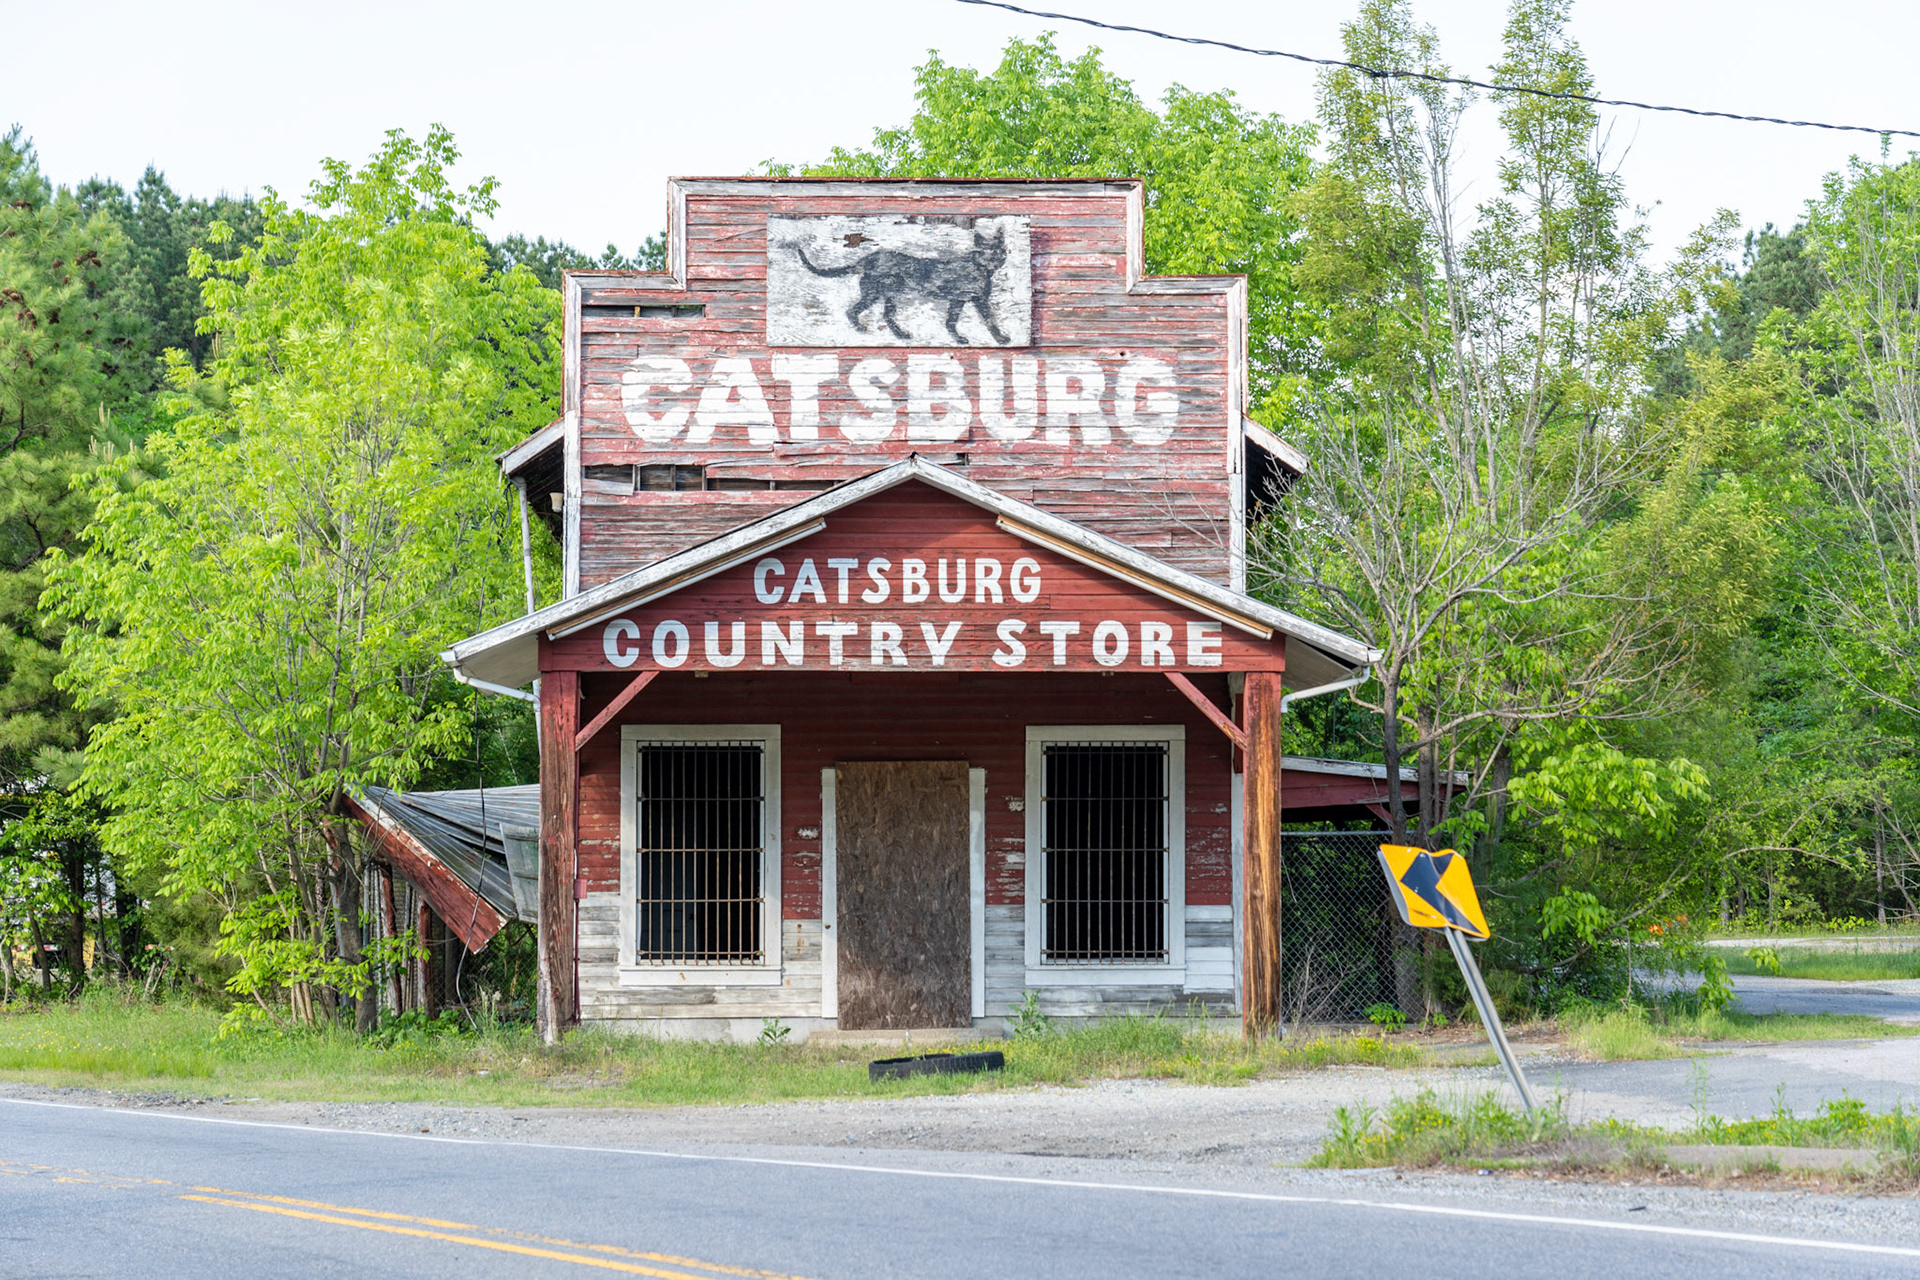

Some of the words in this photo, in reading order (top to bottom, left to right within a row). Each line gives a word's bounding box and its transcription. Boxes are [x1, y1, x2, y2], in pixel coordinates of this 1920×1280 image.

[620, 355, 1180, 446] CATSBURG
[753, 557, 1042, 604] CATSBURG
[602, 619, 962, 668] COUNTRY
[992, 619, 1223, 667] STORE
